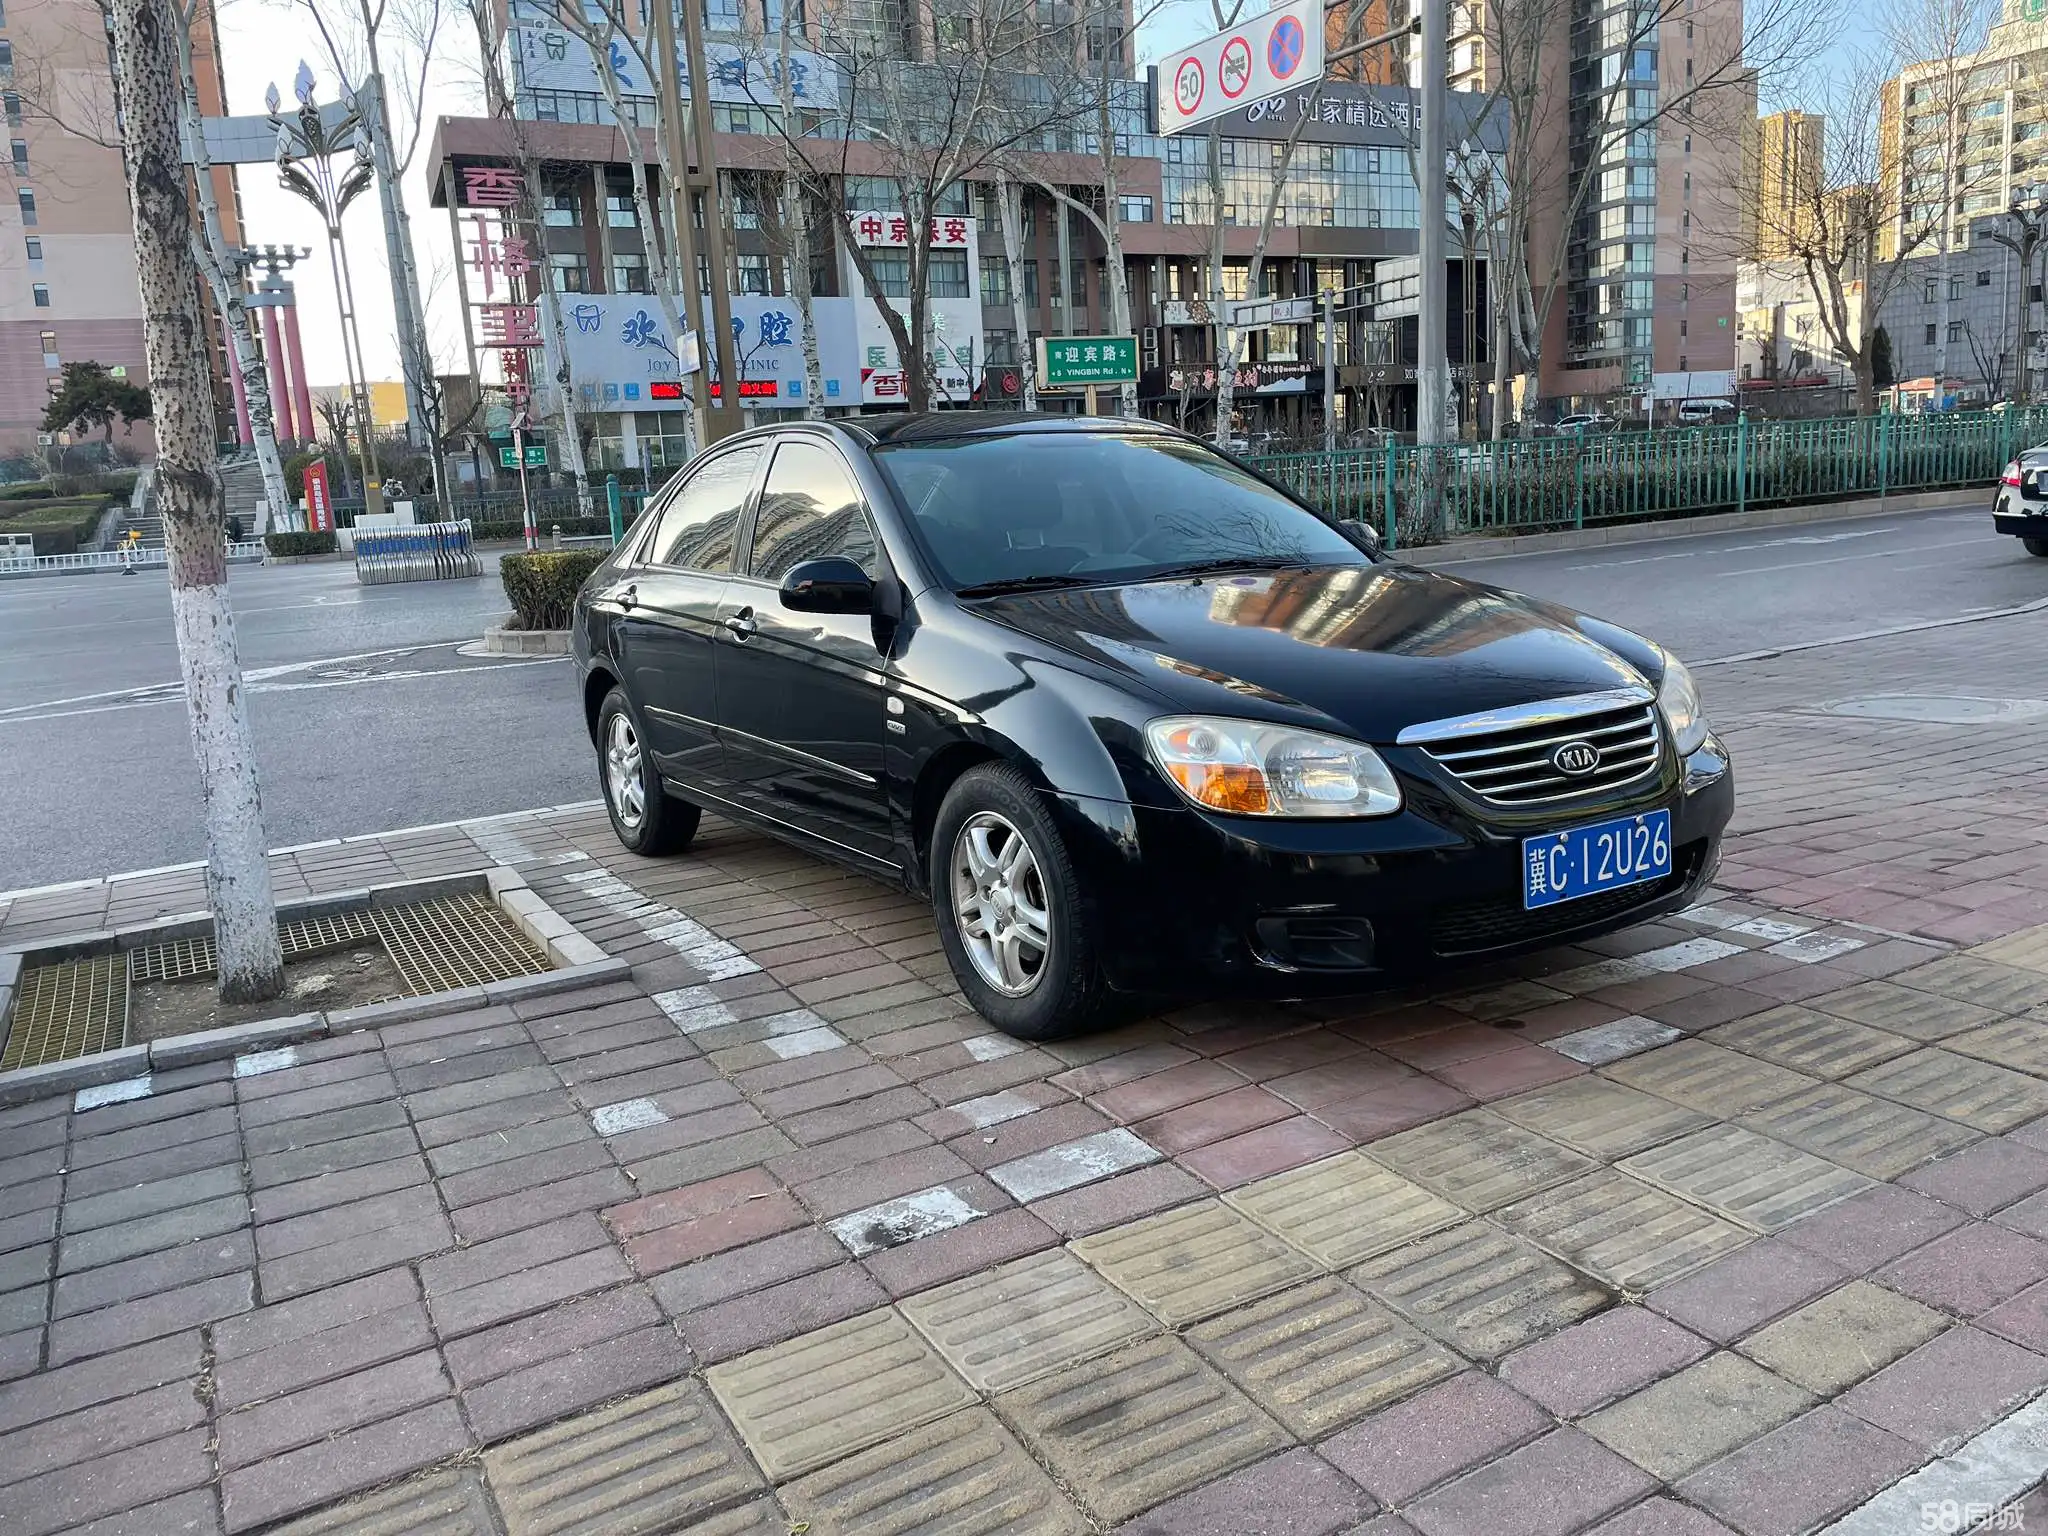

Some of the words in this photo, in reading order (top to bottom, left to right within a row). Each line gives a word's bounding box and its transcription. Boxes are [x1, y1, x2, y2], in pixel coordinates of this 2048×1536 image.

[1179, 71, 1199, 101] 50
[463, 167, 544, 347] 香格里
[1065, 344, 1117, 363] 迎宾路
[1119, 349, 1127, 357] 北
[735, 359, 779, 371] CLINIC
[1066, 367, 1101, 376] YINGBIN
[1562, 749, 1596, 769] KIA
